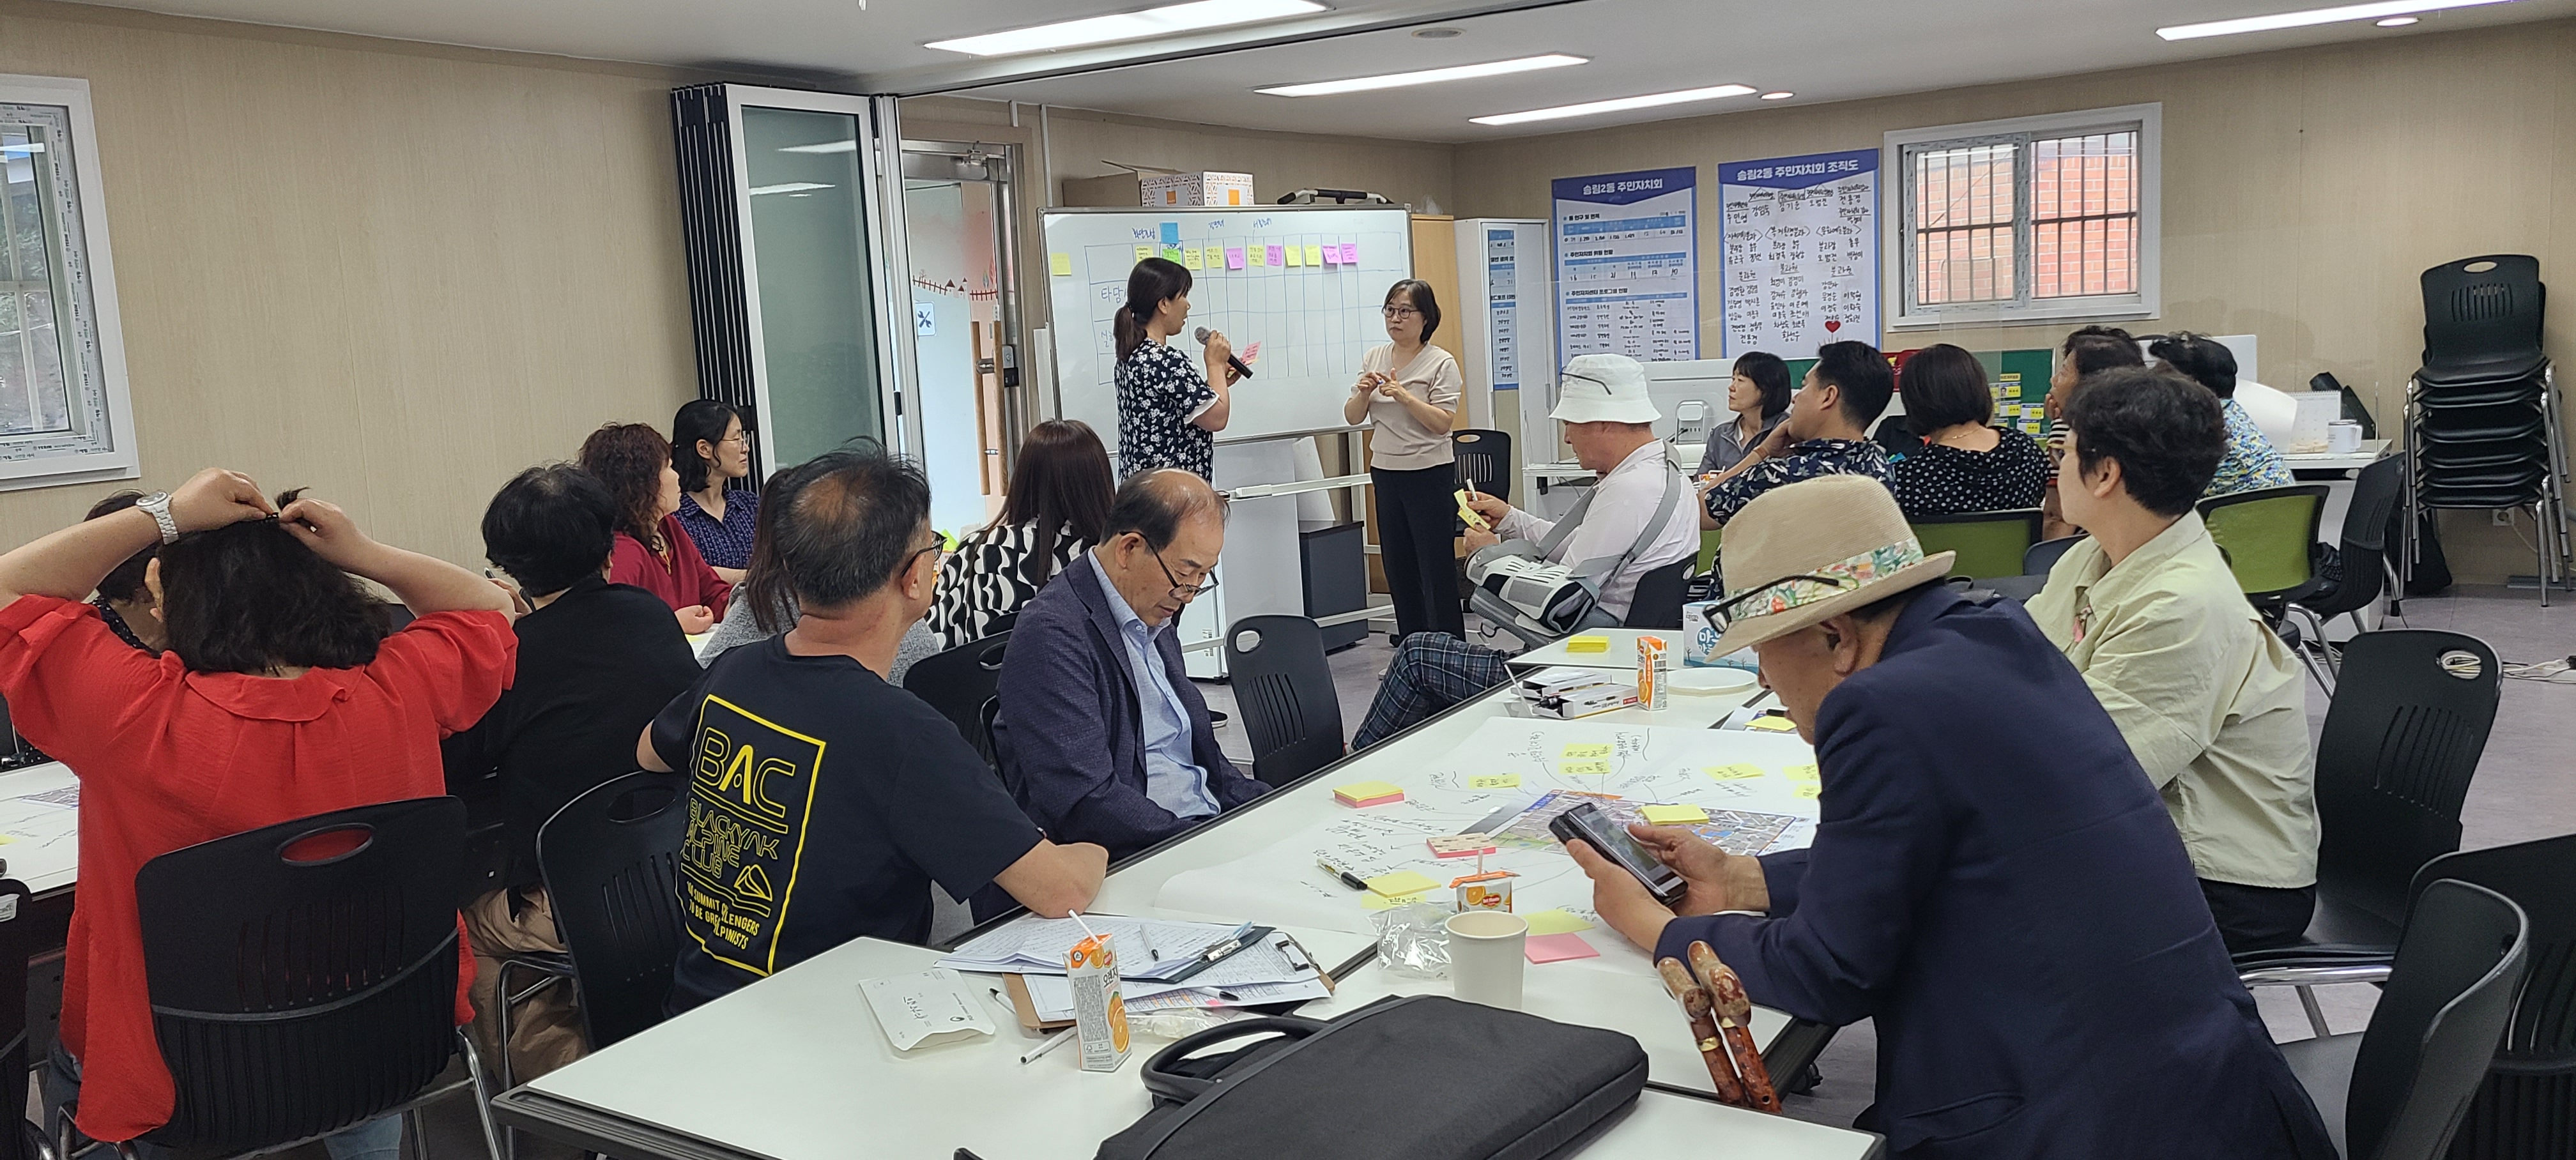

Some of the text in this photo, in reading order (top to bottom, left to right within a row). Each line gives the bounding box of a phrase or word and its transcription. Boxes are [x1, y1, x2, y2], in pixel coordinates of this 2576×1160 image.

[1737, 159, 1859, 181] 송림2동 주민자치회 조직도
[1583, 178, 1664, 195] 송림2동 주민자치회
[1101, 286, 1127, 303] 타당
[695, 726, 796, 818] BAC
[689, 798, 780, 860] BLACKYAK
[686, 820, 740, 868] ALPINE
[681, 839, 723, 880] CLUB
[694, 889, 720, 912] SUMMIT
[695, 904, 703, 920] BE
[1103, 965, 1119, 988] 오렌지
